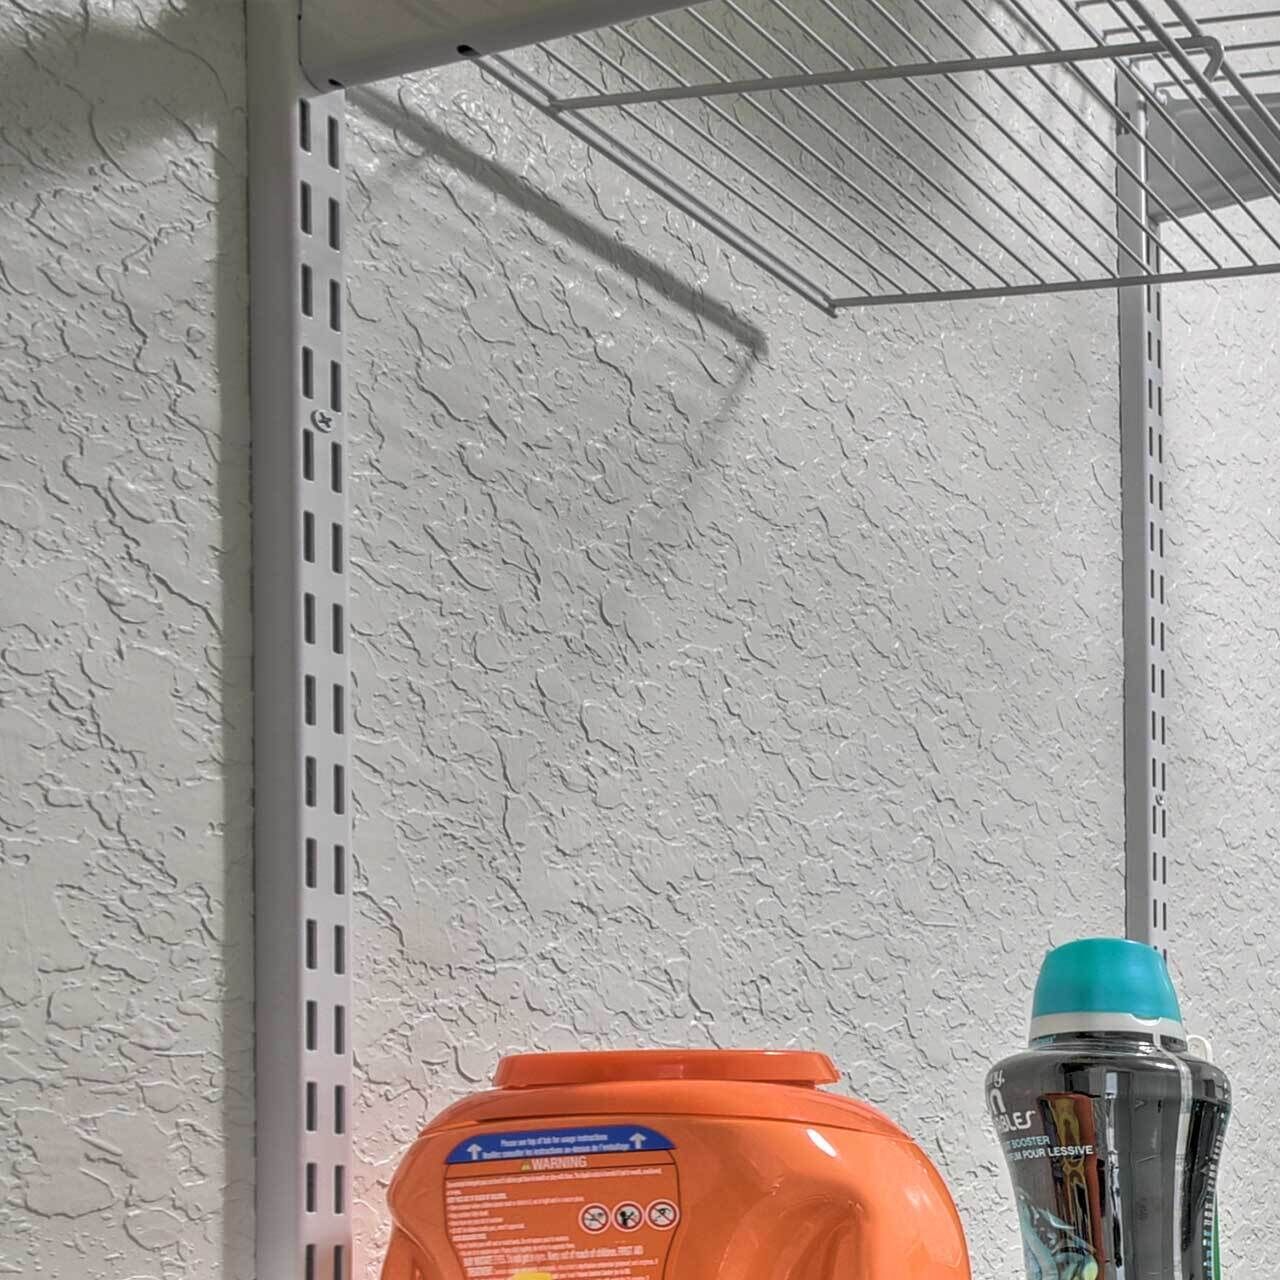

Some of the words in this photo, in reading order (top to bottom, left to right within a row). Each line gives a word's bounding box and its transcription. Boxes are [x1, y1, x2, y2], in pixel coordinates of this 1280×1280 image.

[1022, 1147, 1046, 1160] POUR
[1048, 1145, 1094, 1157] LESSIVE
[531, 1156, 587, 1170] WARNING
